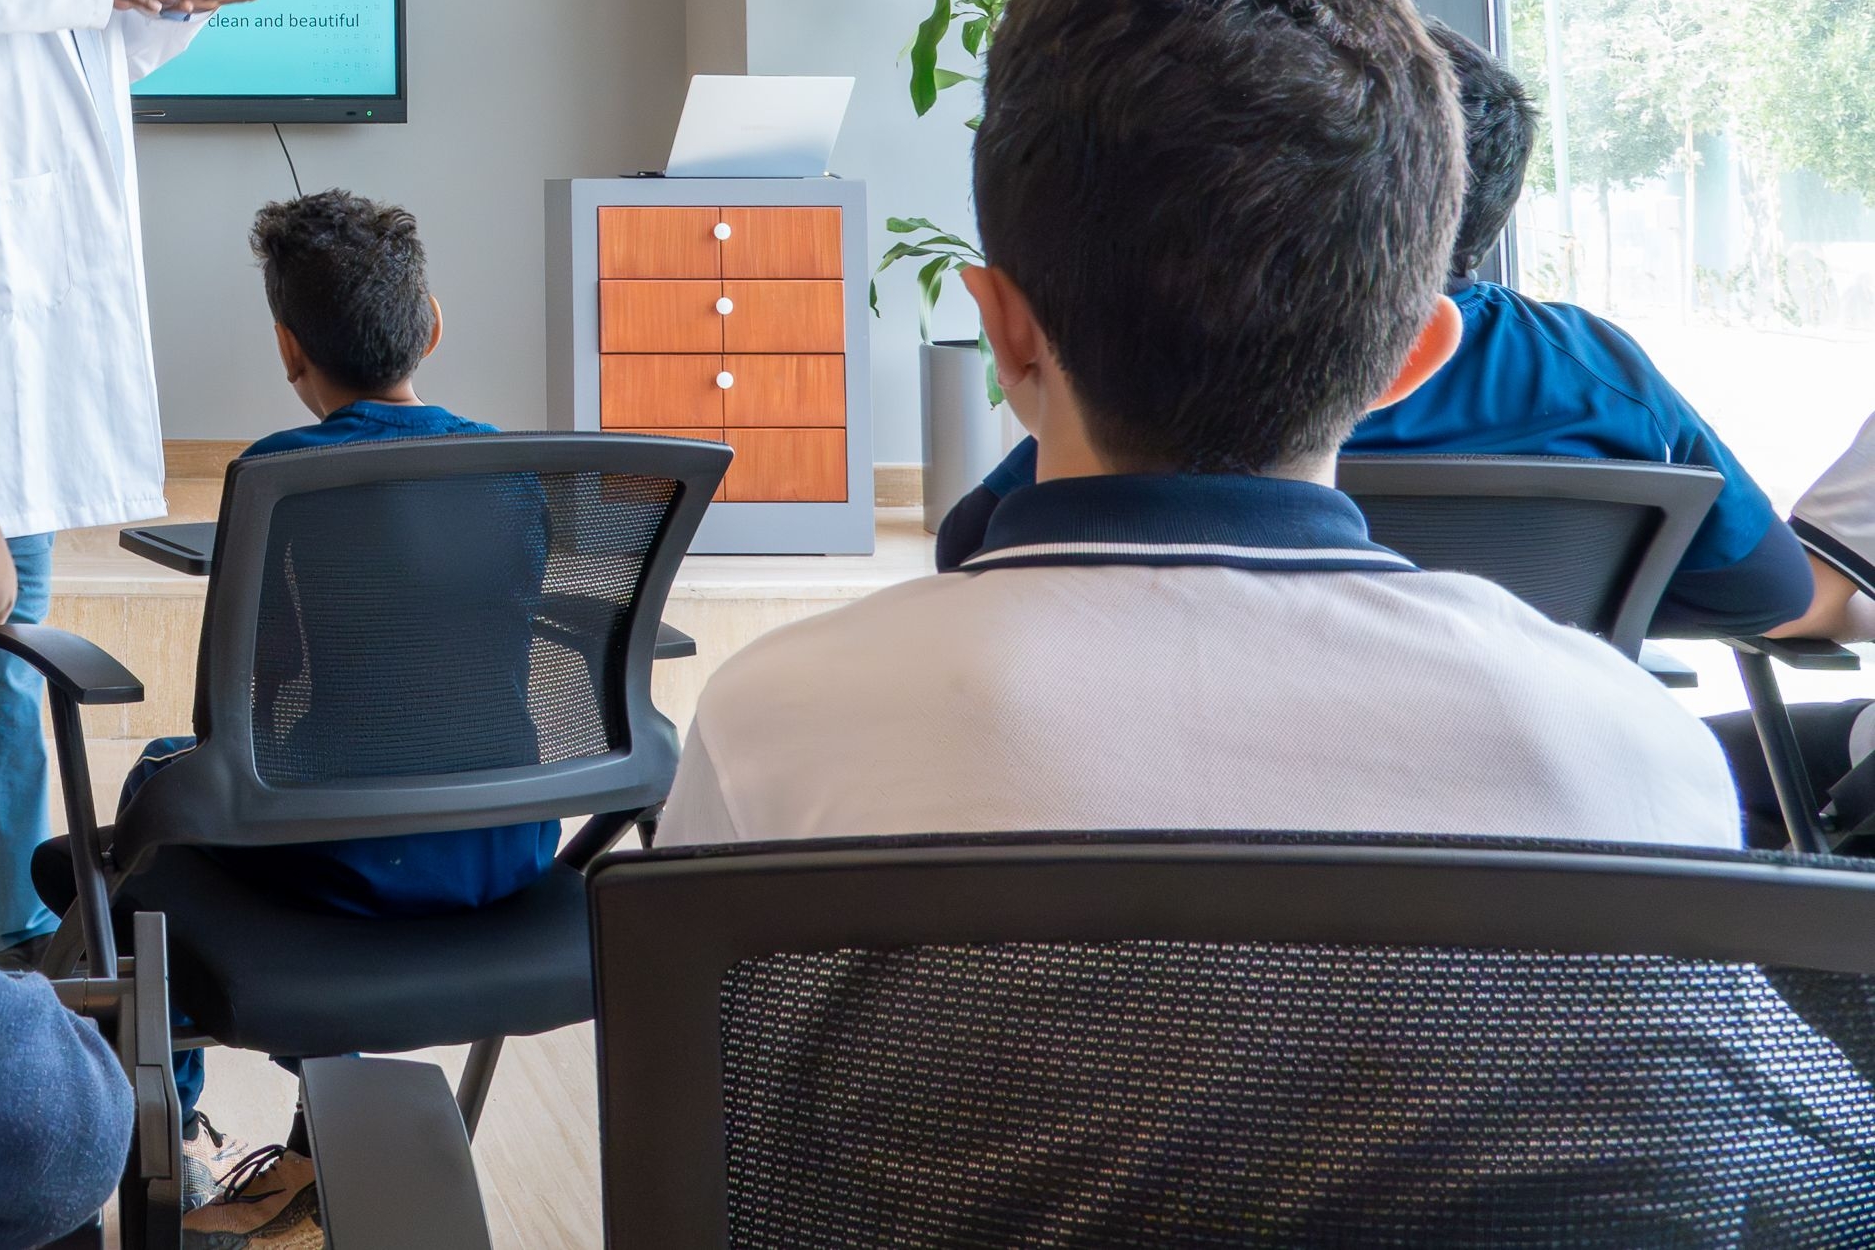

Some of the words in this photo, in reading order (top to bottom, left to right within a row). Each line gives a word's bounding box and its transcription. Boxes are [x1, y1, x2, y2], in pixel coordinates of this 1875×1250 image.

[208, 14, 249, 28] clean
[254, 13, 284, 28] and
[289, 12, 359, 28] beautiful
